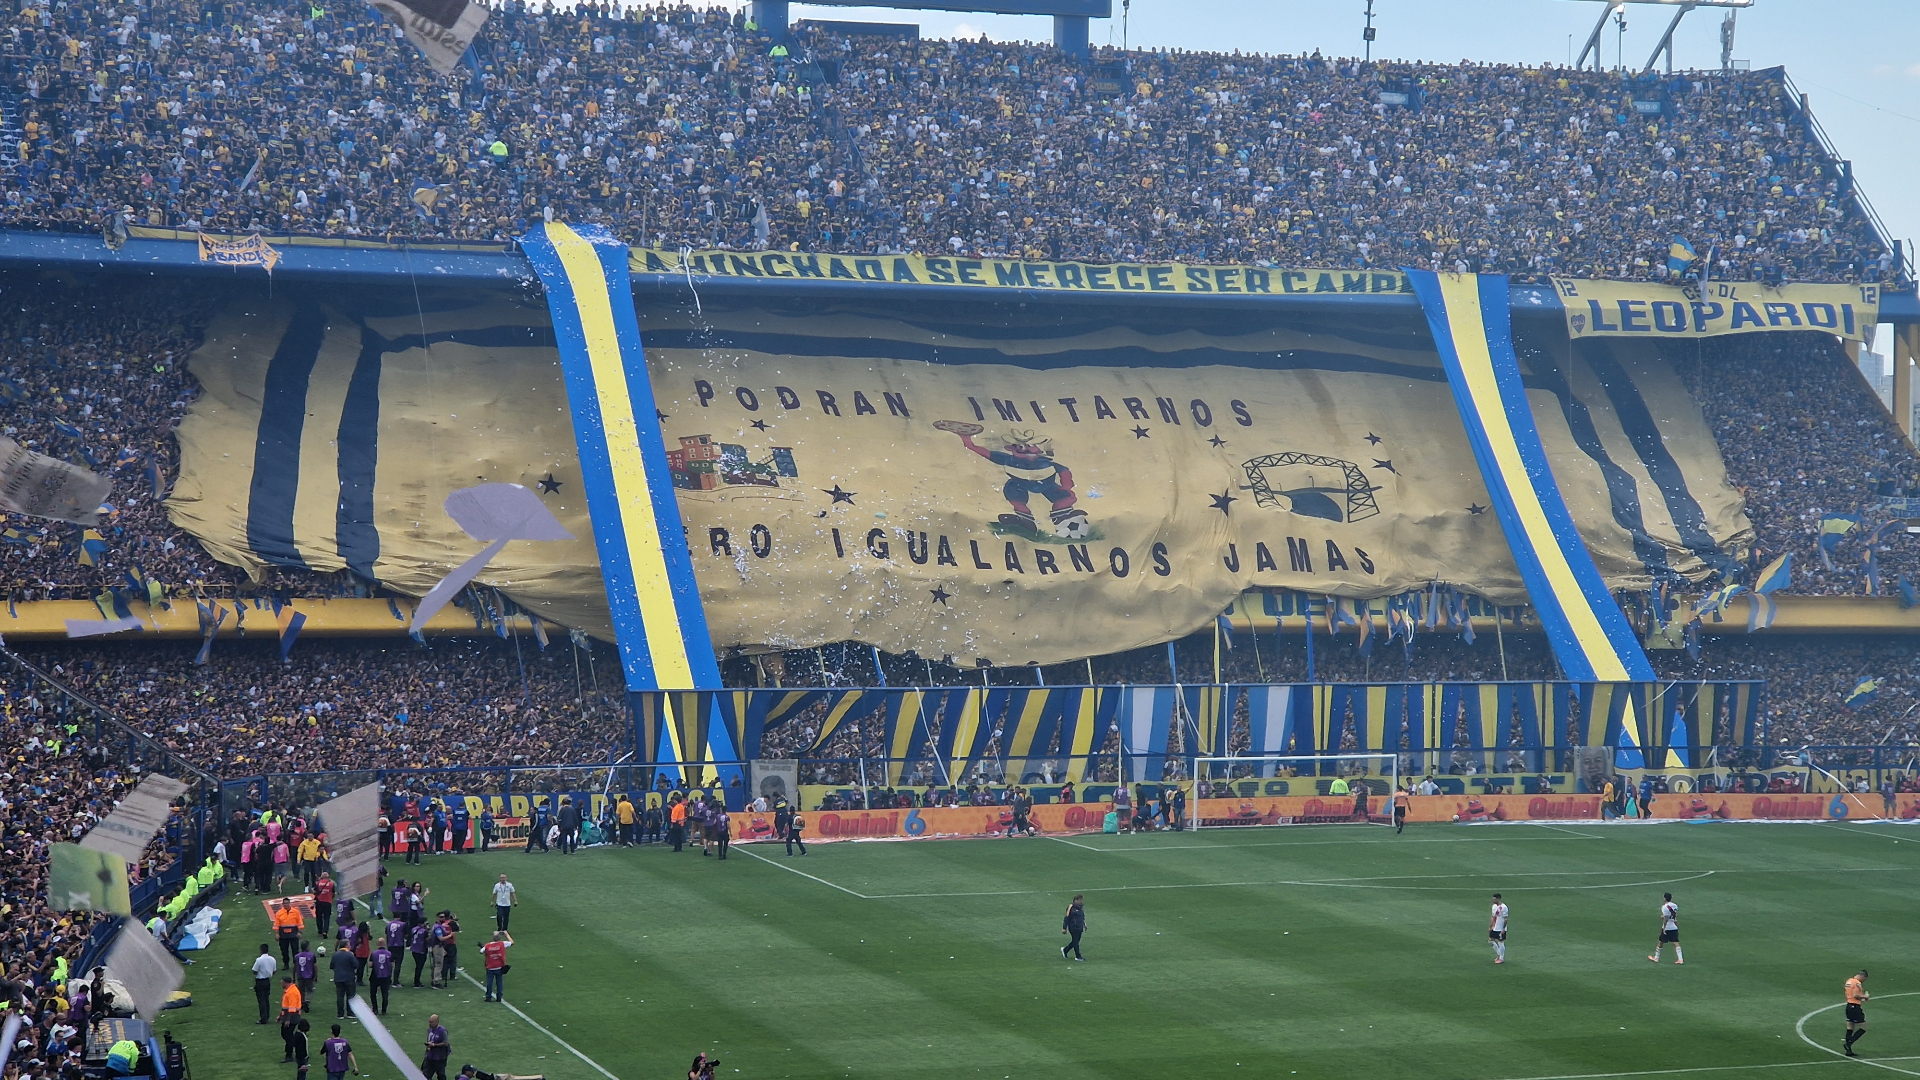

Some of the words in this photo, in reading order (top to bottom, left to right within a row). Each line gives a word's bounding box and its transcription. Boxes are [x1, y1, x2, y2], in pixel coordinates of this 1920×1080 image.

[678, 252, 920, 284] HINCHADA
[924, 258, 988, 286] SE
[993, 261, 1177, 293] MERECE
[1186, 267, 1271, 294] SER
[1556, 279, 1579, 297] 12
[1718, 283, 1740, 301] DL
[1859, 286, 1877, 304] 12
[1586, 298, 1855, 335] LEOPARDI
[693, 379, 912, 418] PODRAN
[967, 394, 1255, 428] IMITARNOS
[831, 526, 1172, 578] IGUALARNOS
[1222, 536, 1376, 576] JAMAS
[1528, 796, 1601, 819] Quini
[1751, 796, 1824, 818] Quini
[1828, 795, 1849, 818] 6
[819, 812, 898, 836] Quini
[904, 809, 927, 836] 6
[1202, 817, 1263, 827] LUSQTOFF
[1292, 815, 1351, 824] LUSQTOFF
